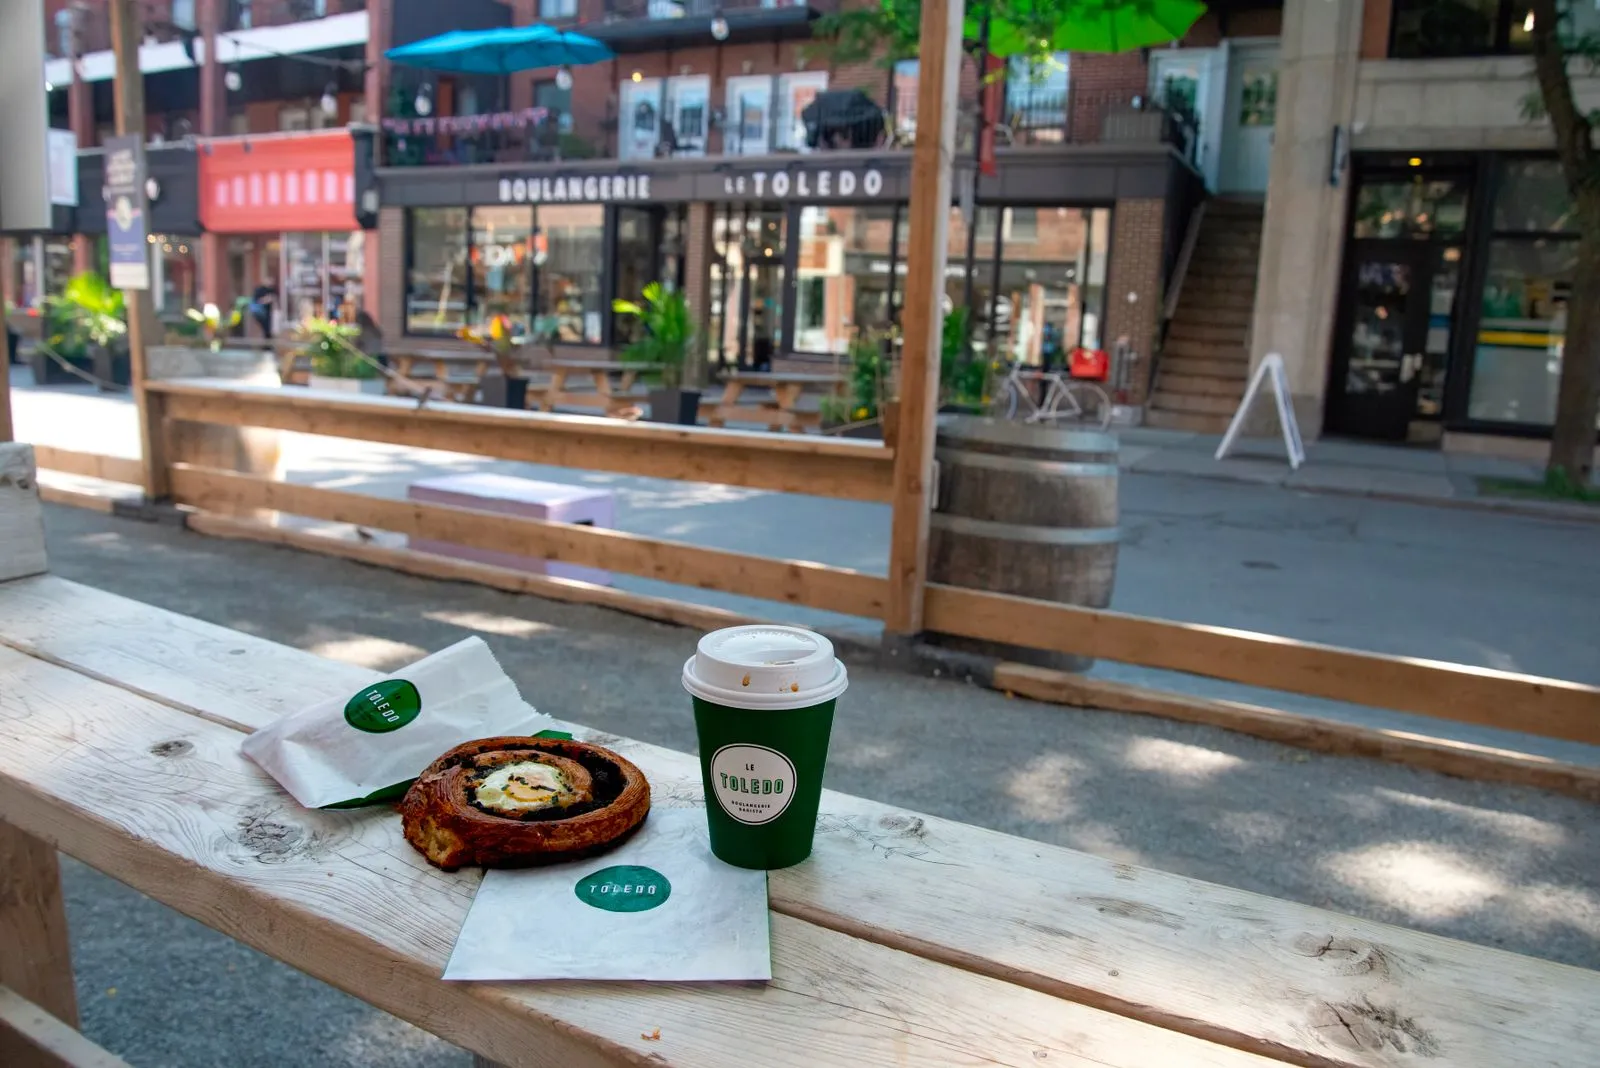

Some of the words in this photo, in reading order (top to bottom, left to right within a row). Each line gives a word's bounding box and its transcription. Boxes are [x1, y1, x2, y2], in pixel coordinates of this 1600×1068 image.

[499, 175, 650, 202] BOULANGERIE
[724, 175, 746, 195] LE
[752, 169, 882, 198] TOLEDO
[365, 689, 400, 722] TOLEDO
[745, 763, 755, 771] LE
[720, 772, 784, 795] TOLEDO
[731, 800, 771, 809] BOULANGERIE
[590, 884, 657, 895] TOLEDO
